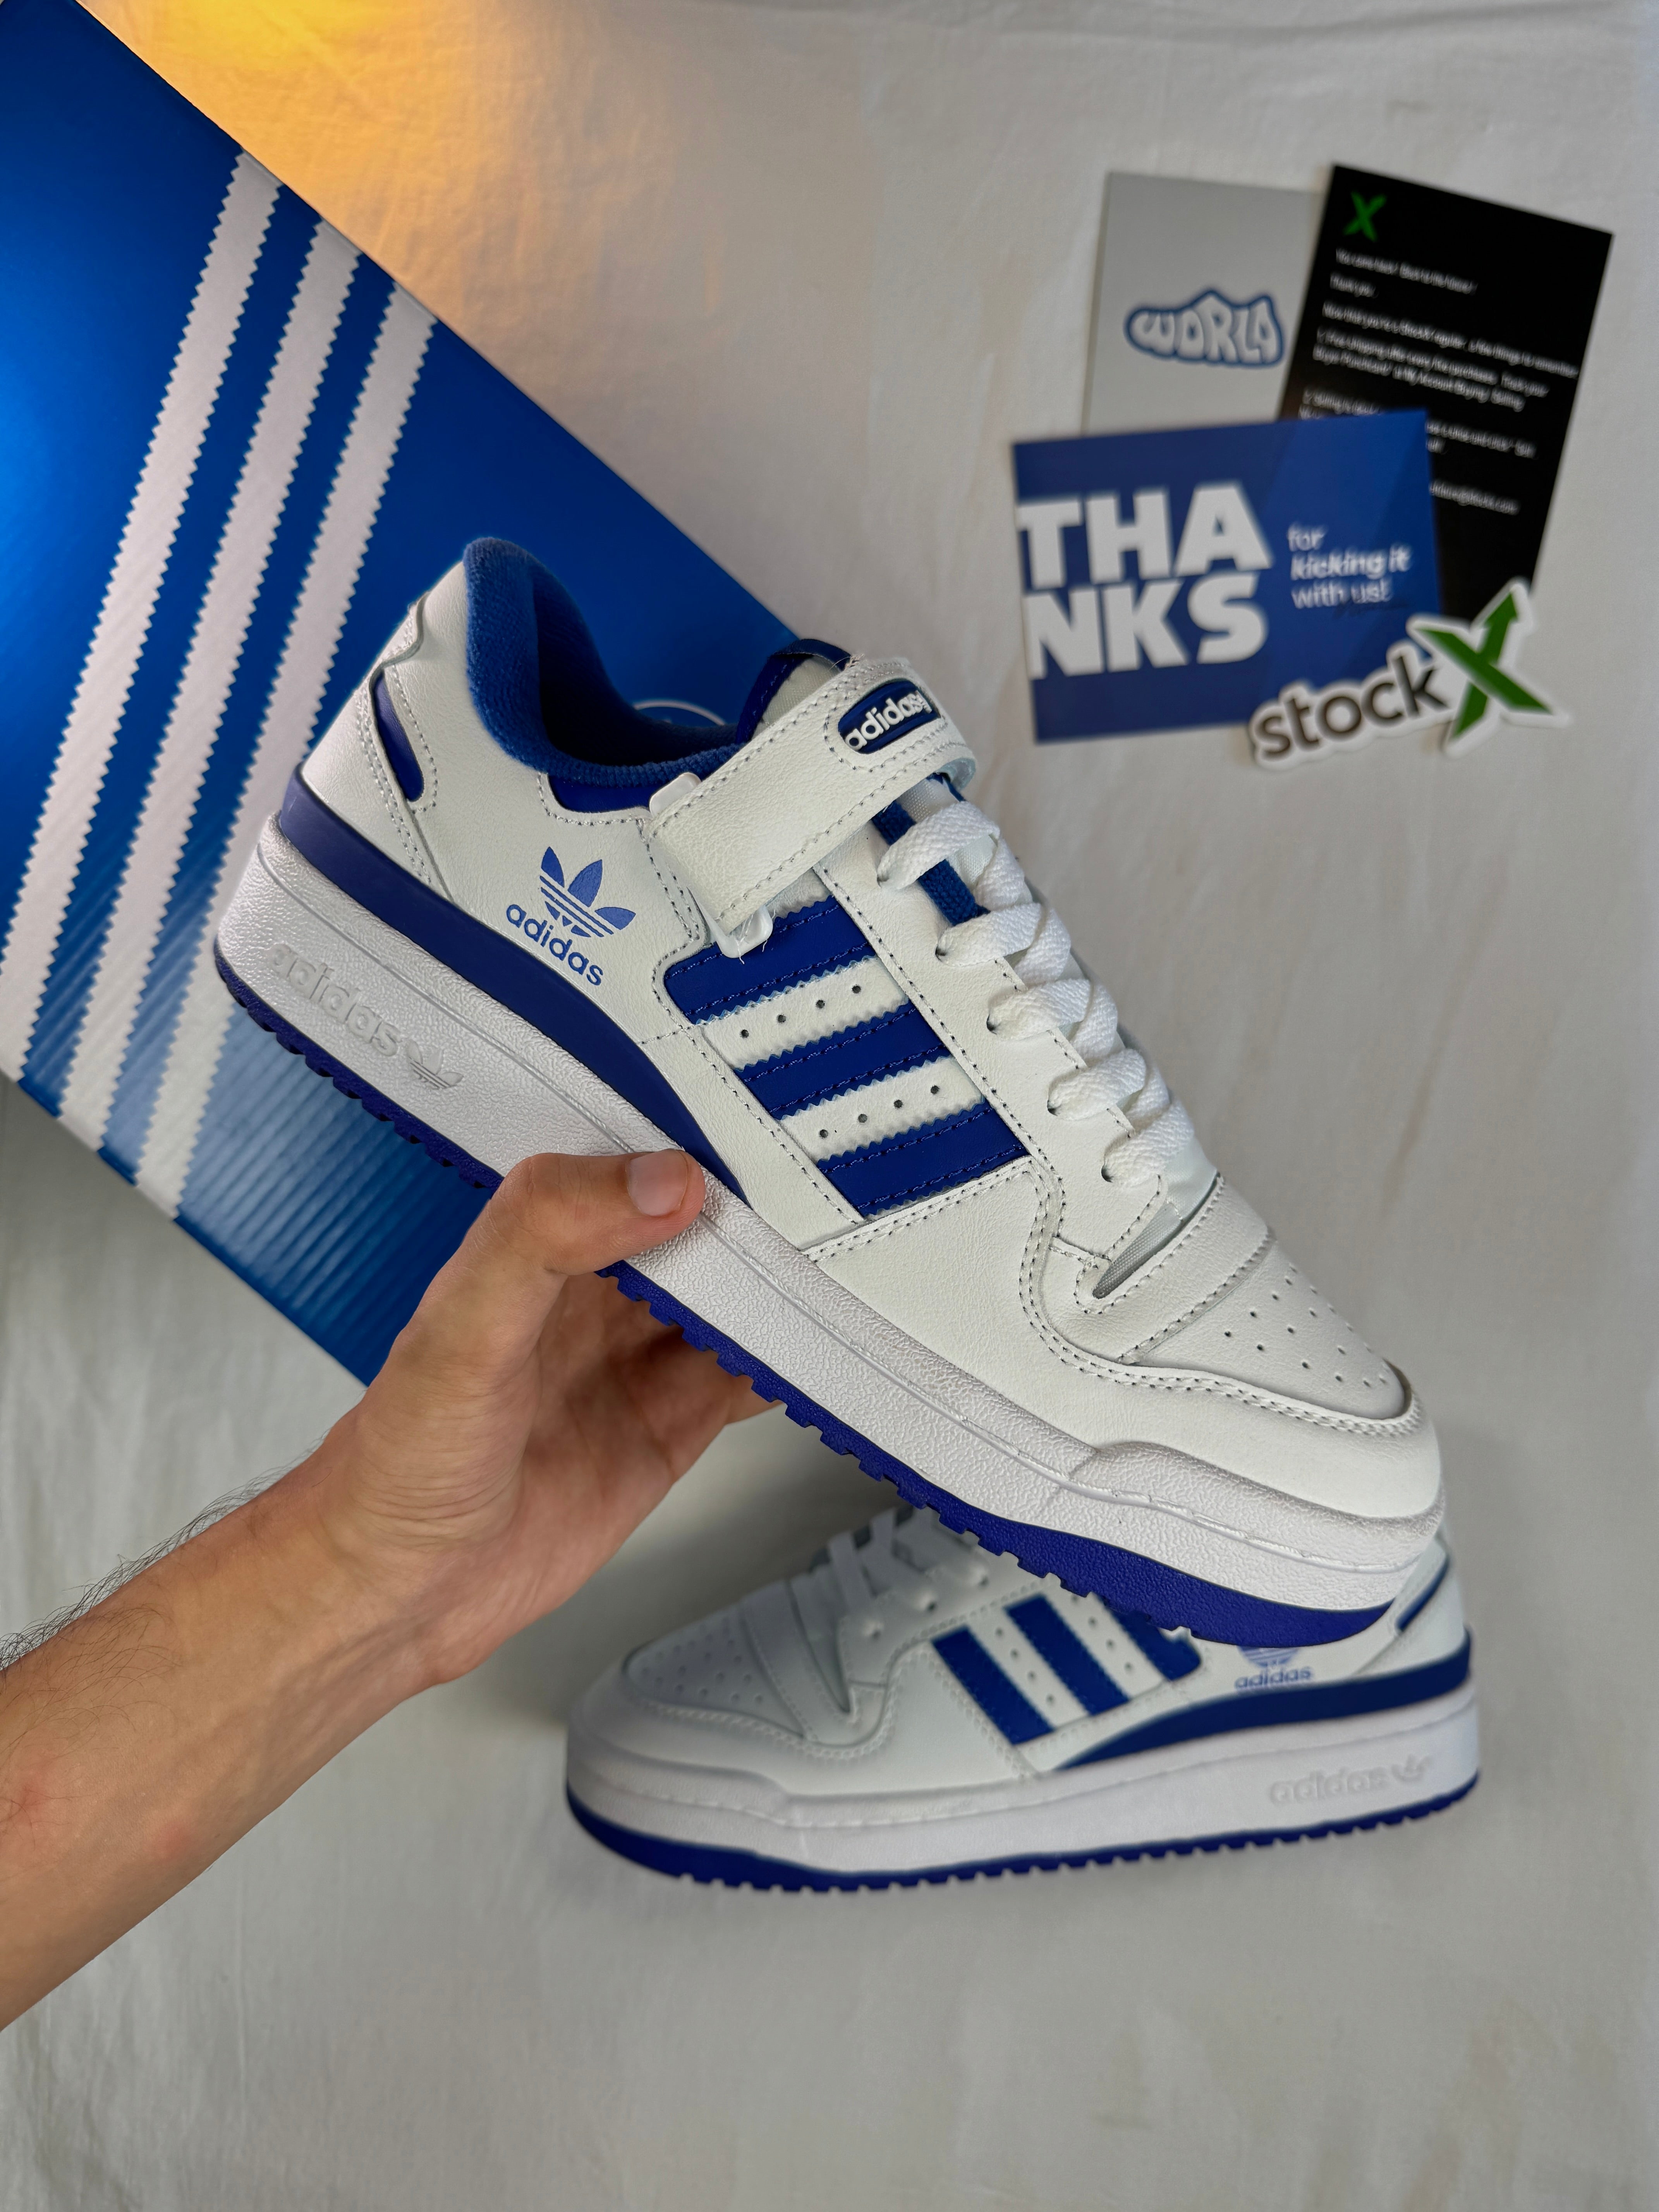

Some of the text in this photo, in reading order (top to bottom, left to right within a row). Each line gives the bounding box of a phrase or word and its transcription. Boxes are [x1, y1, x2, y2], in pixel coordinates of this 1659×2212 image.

[1125, 288, 1284, 368] WORLD
[1015, 479, 1273, 589] THA
[1288, 524, 1326, 551] for
[1291, 543, 1412, 580] kicking it
[1291, 578, 1393, 609] with us!
[1024, 572, 1268, 680] NKS
[844, 693, 928, 750] adidas
[506, 904, 603, 986] adidas
[270, 943, 399, 1057] adidas
[1234, 1666, 1314, 1690] adidas
[1270, 1767, 1389, 1805] adidas
